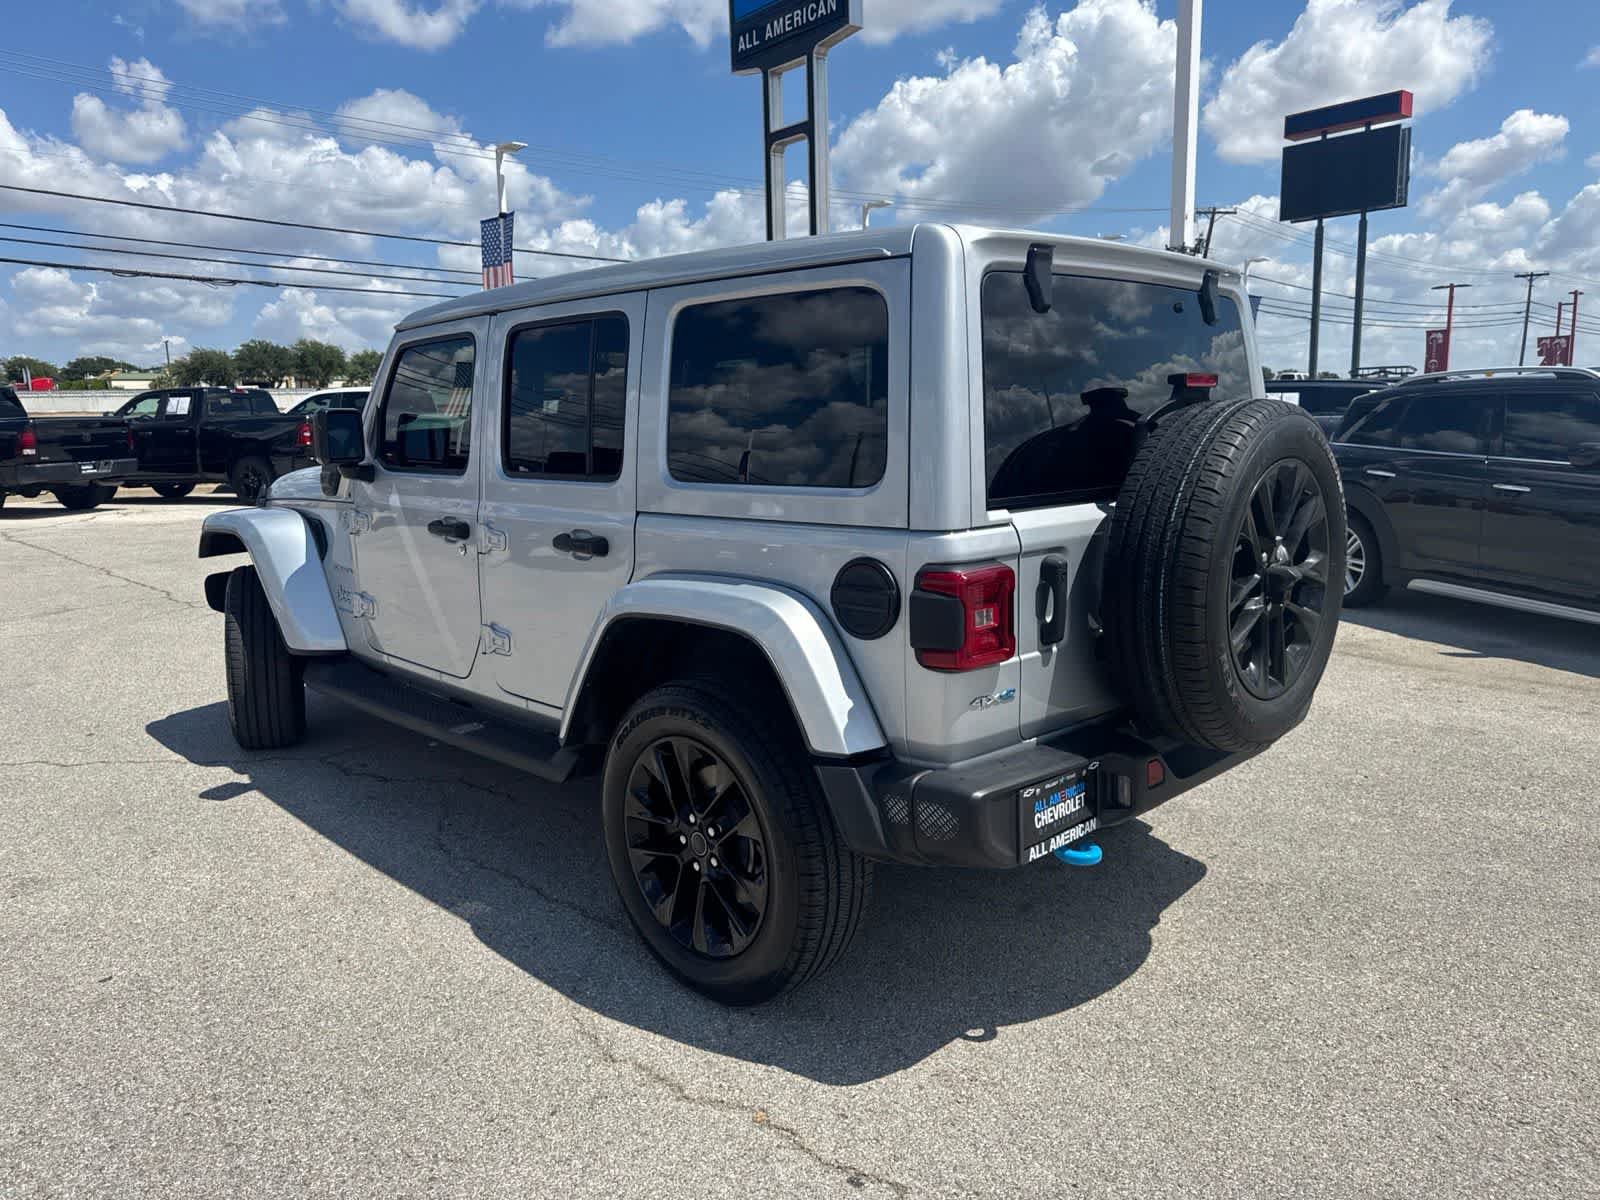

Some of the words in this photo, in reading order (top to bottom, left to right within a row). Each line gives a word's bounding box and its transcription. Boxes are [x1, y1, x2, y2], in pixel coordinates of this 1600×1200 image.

[738, 30, 760, 53] ALL
[765, 0, 837, 41] AMERICAN
[1034, 798, 1048, 813] ALL
[1049, 782, 1086, 806] AMERICAN
[1034, 792, 1086, 829] CHEVROLET
[1029, 844, 1048, 862] ALL
[1049, 817, 1097, 853] AMERICAN
